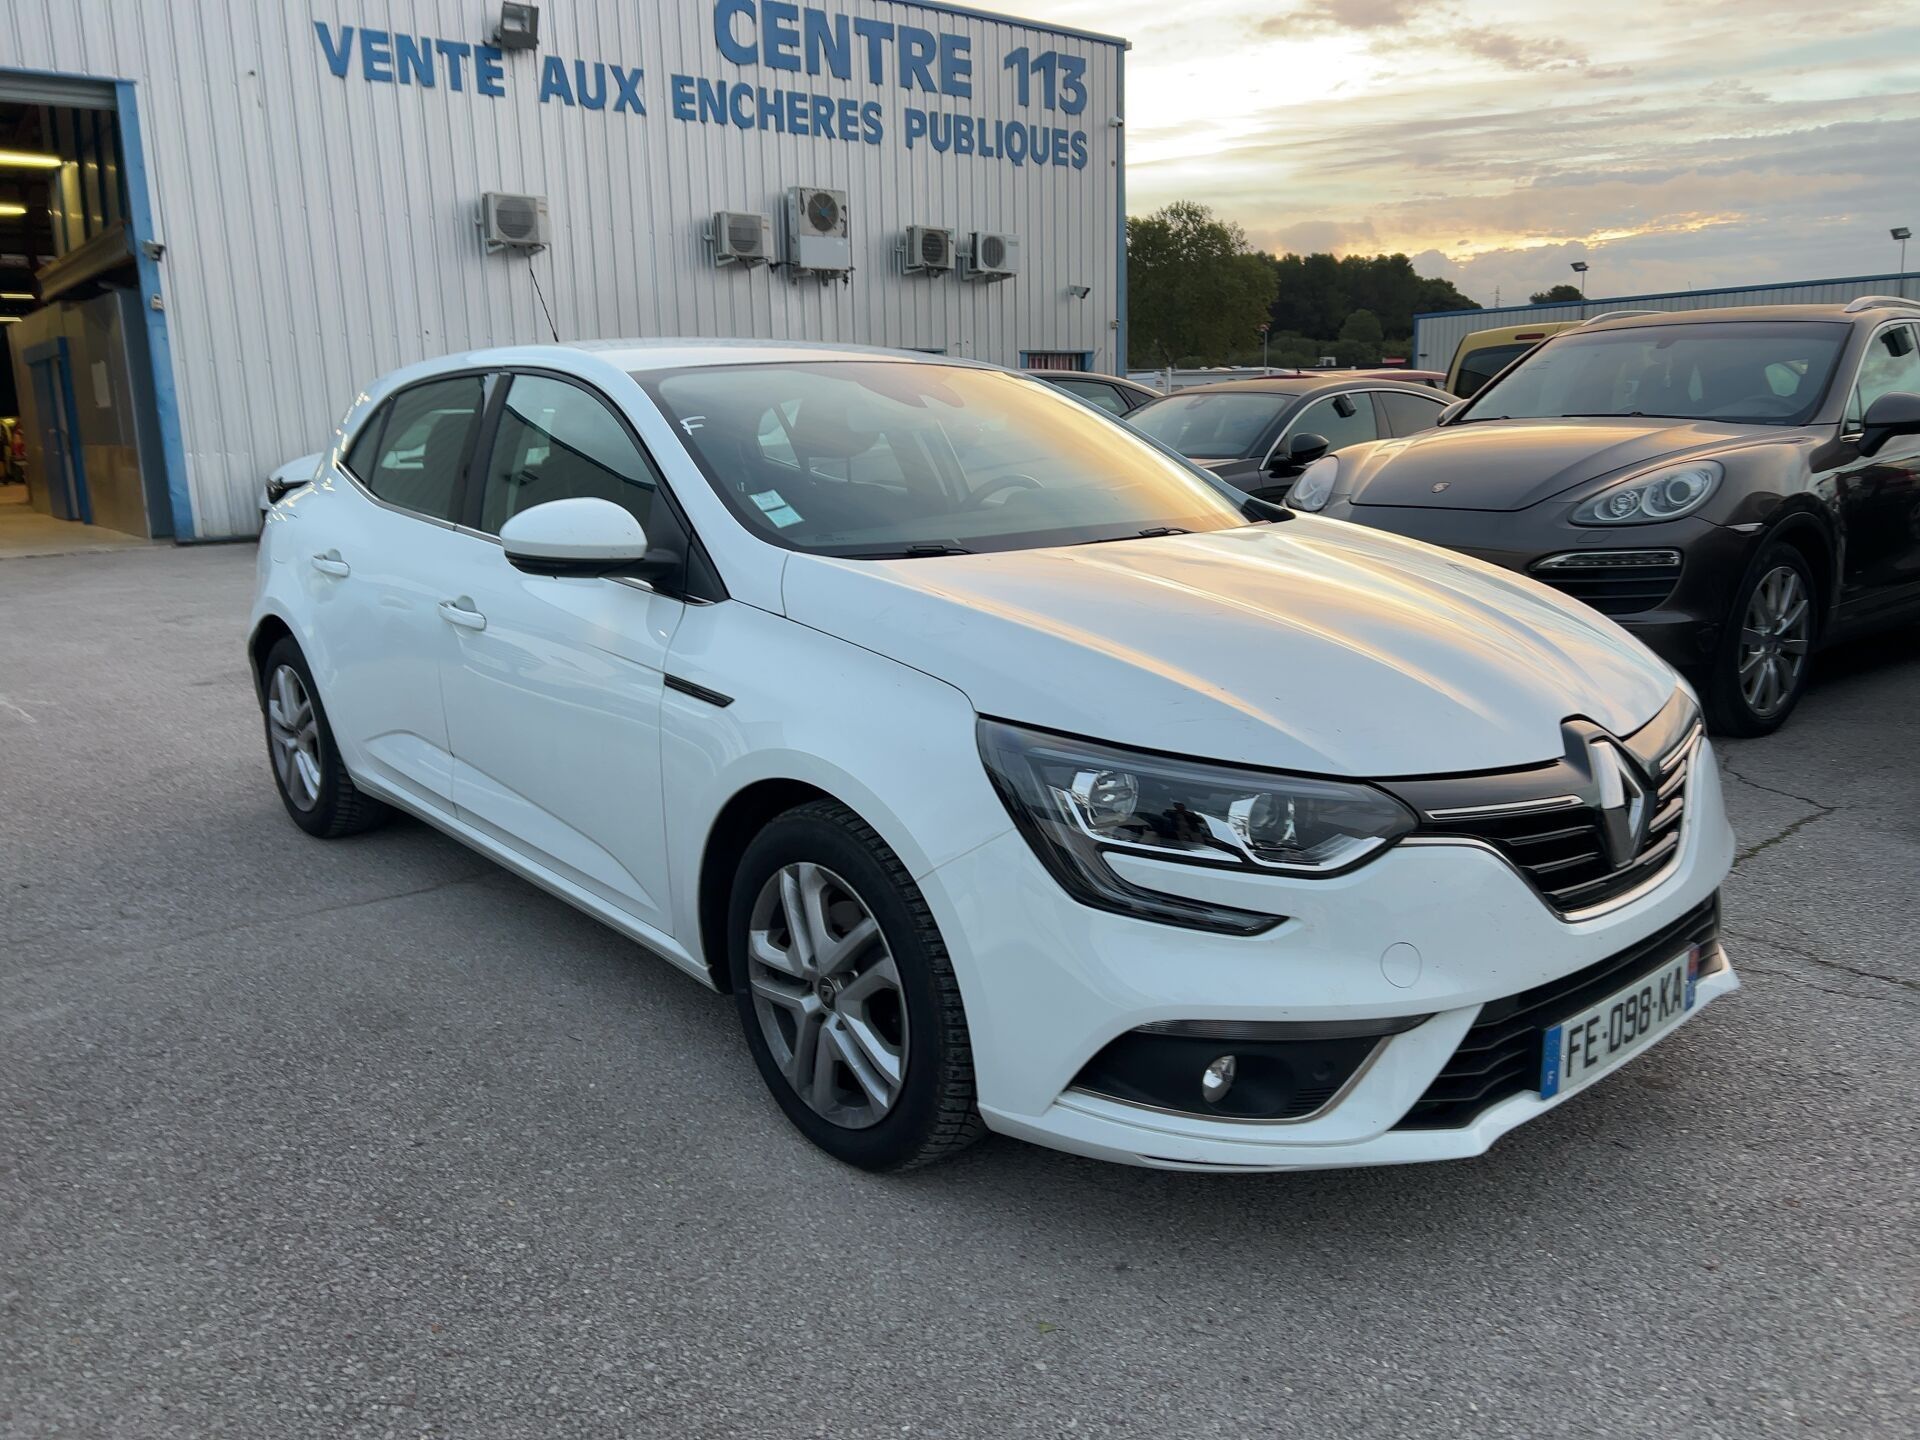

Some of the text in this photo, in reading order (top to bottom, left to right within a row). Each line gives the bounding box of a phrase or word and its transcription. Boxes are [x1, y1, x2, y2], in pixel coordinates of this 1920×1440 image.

[313, 21, 1089, 170] VENTE AUX ENCHERES PUBLIQUES
[713, 0, 1088, 116] CENTRE 113
[1566, 966, 1684, 1078] FE-098-KA
